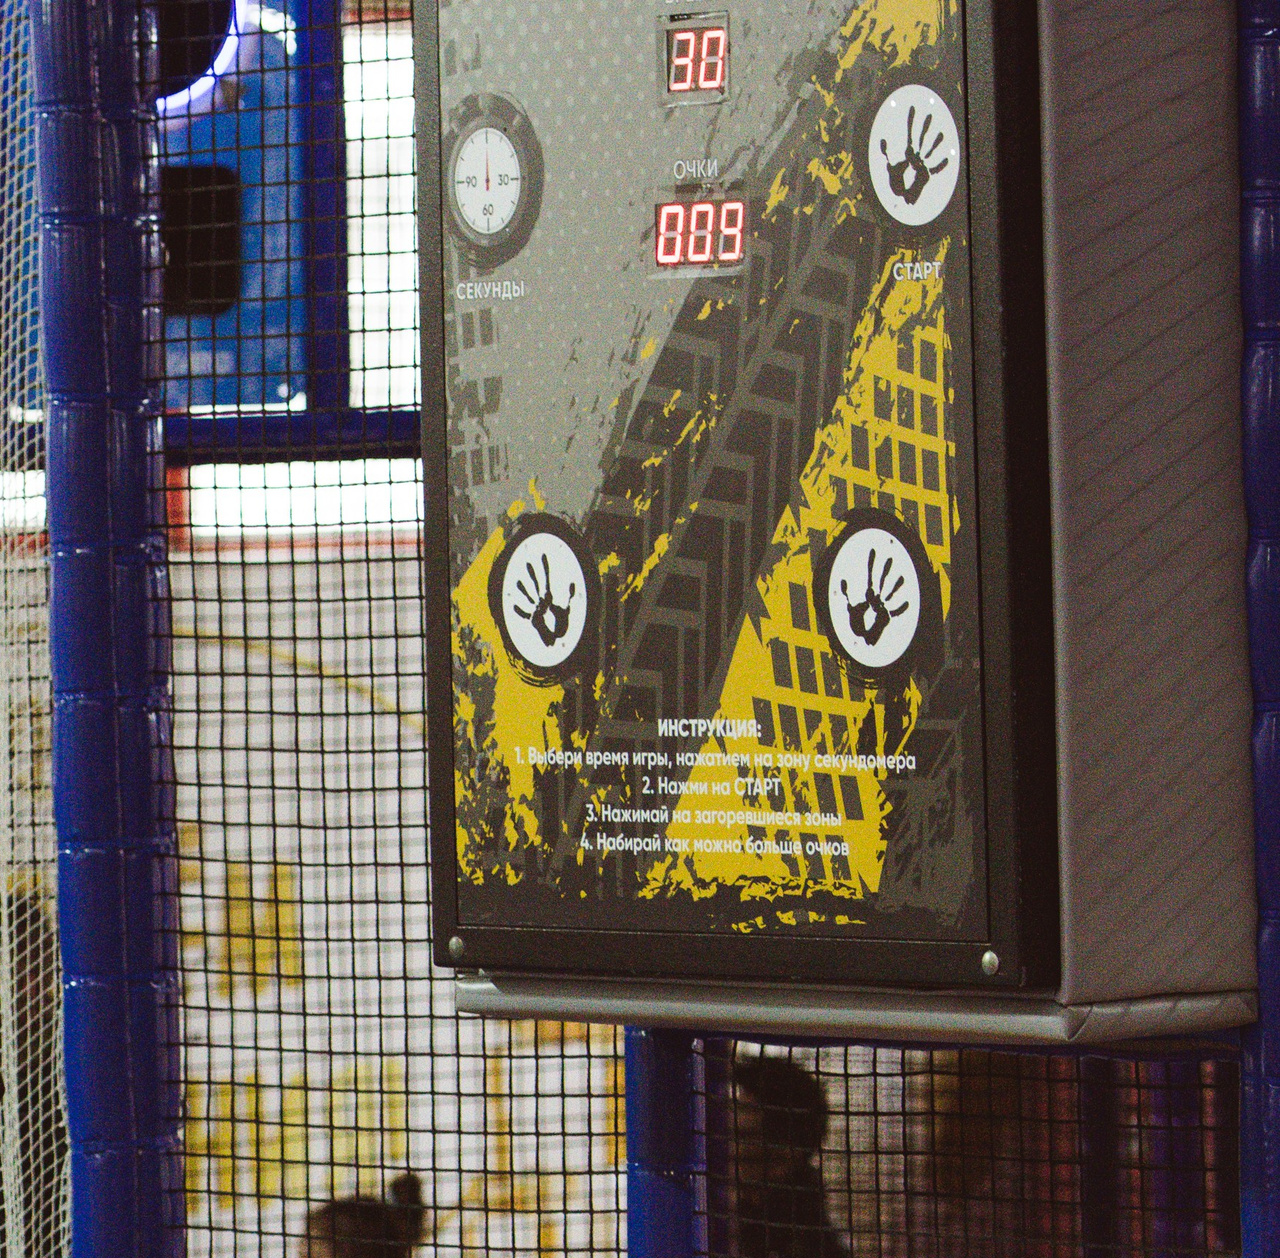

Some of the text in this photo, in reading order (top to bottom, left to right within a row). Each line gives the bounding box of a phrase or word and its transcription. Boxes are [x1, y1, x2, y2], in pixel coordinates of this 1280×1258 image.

[669, 30, 725, 91] 30
[673, 158, 718, 179] ОЧКИ
[465, 175, 478, 188] 90
[497, 173, 510, 186] 30
[482, 203, 494, 216] 60
[657, 202, 743, 263] 009
[893, 261, 941, 281] СТАРТ
[456, 280, 525, 301] СЕКУНДЫ
[657, 718, 762, 740] ИНСТРУКЦИЯ:
[514, 746, 916, 774] 1. Выбери время игры, нажатием на зону секундомера
[642, 775, 782, 796] 2. Нажми на СТАРТ
[585, 803, 842, 828] 3. Нажимай на загоревшиеся зоны
[580, 832, 850, 856] 4. Набирай как можно больше очков
